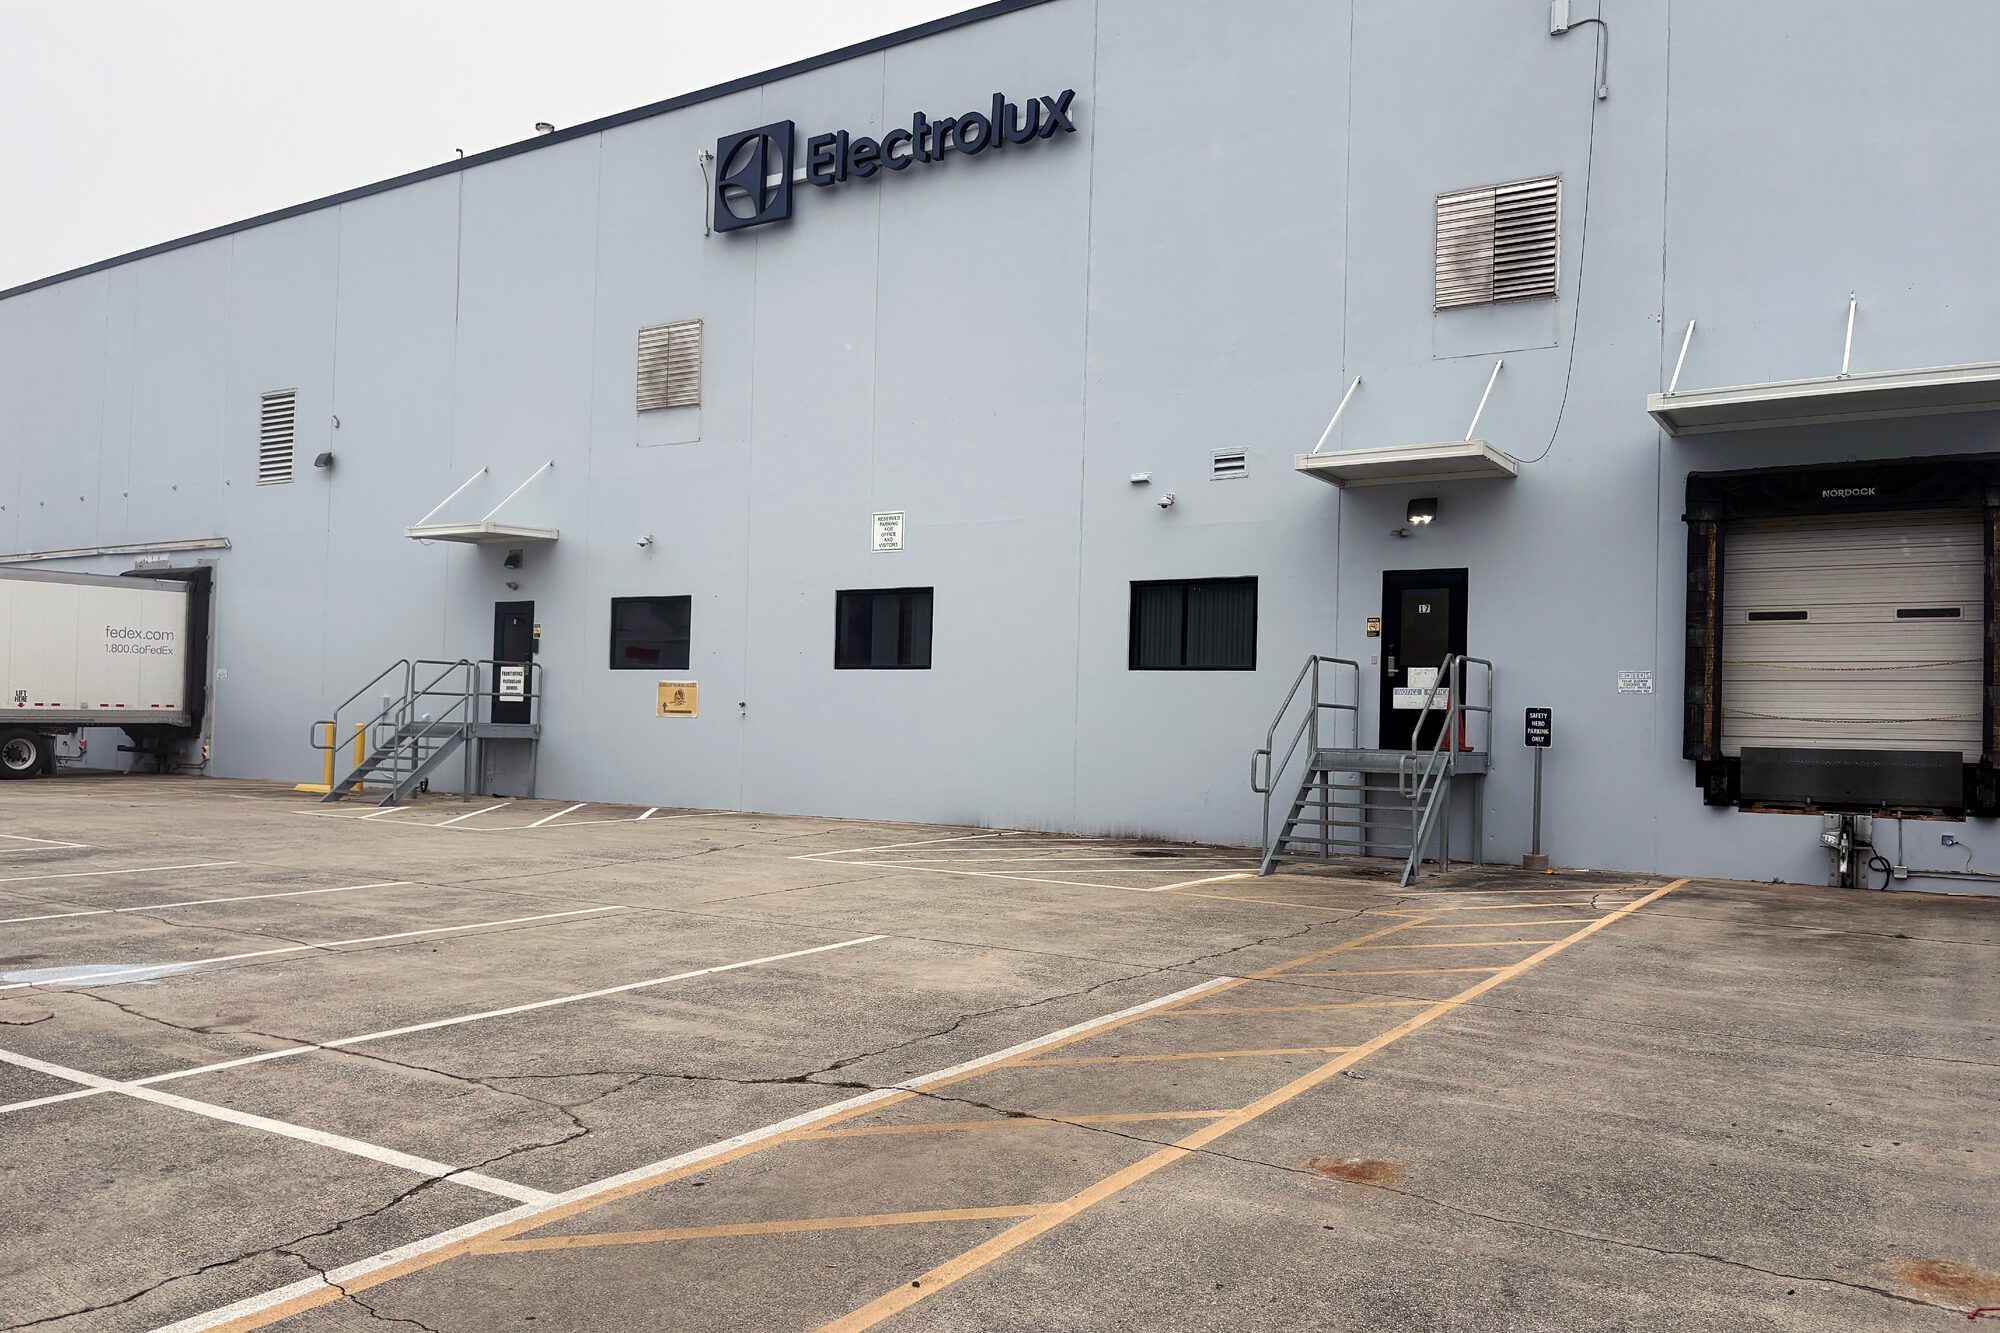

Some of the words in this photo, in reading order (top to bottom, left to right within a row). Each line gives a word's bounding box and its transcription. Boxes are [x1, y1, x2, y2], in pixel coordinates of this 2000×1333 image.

[807, 88, 1077, 188] Electrolux
[1822, 487, 1876, 498] NORDOCK
[1420, 605, 1430, 613] 17
[105, 625, 175, 641] fedex.com
[105, 643, 174, 655] 1.800.GoFedEx
